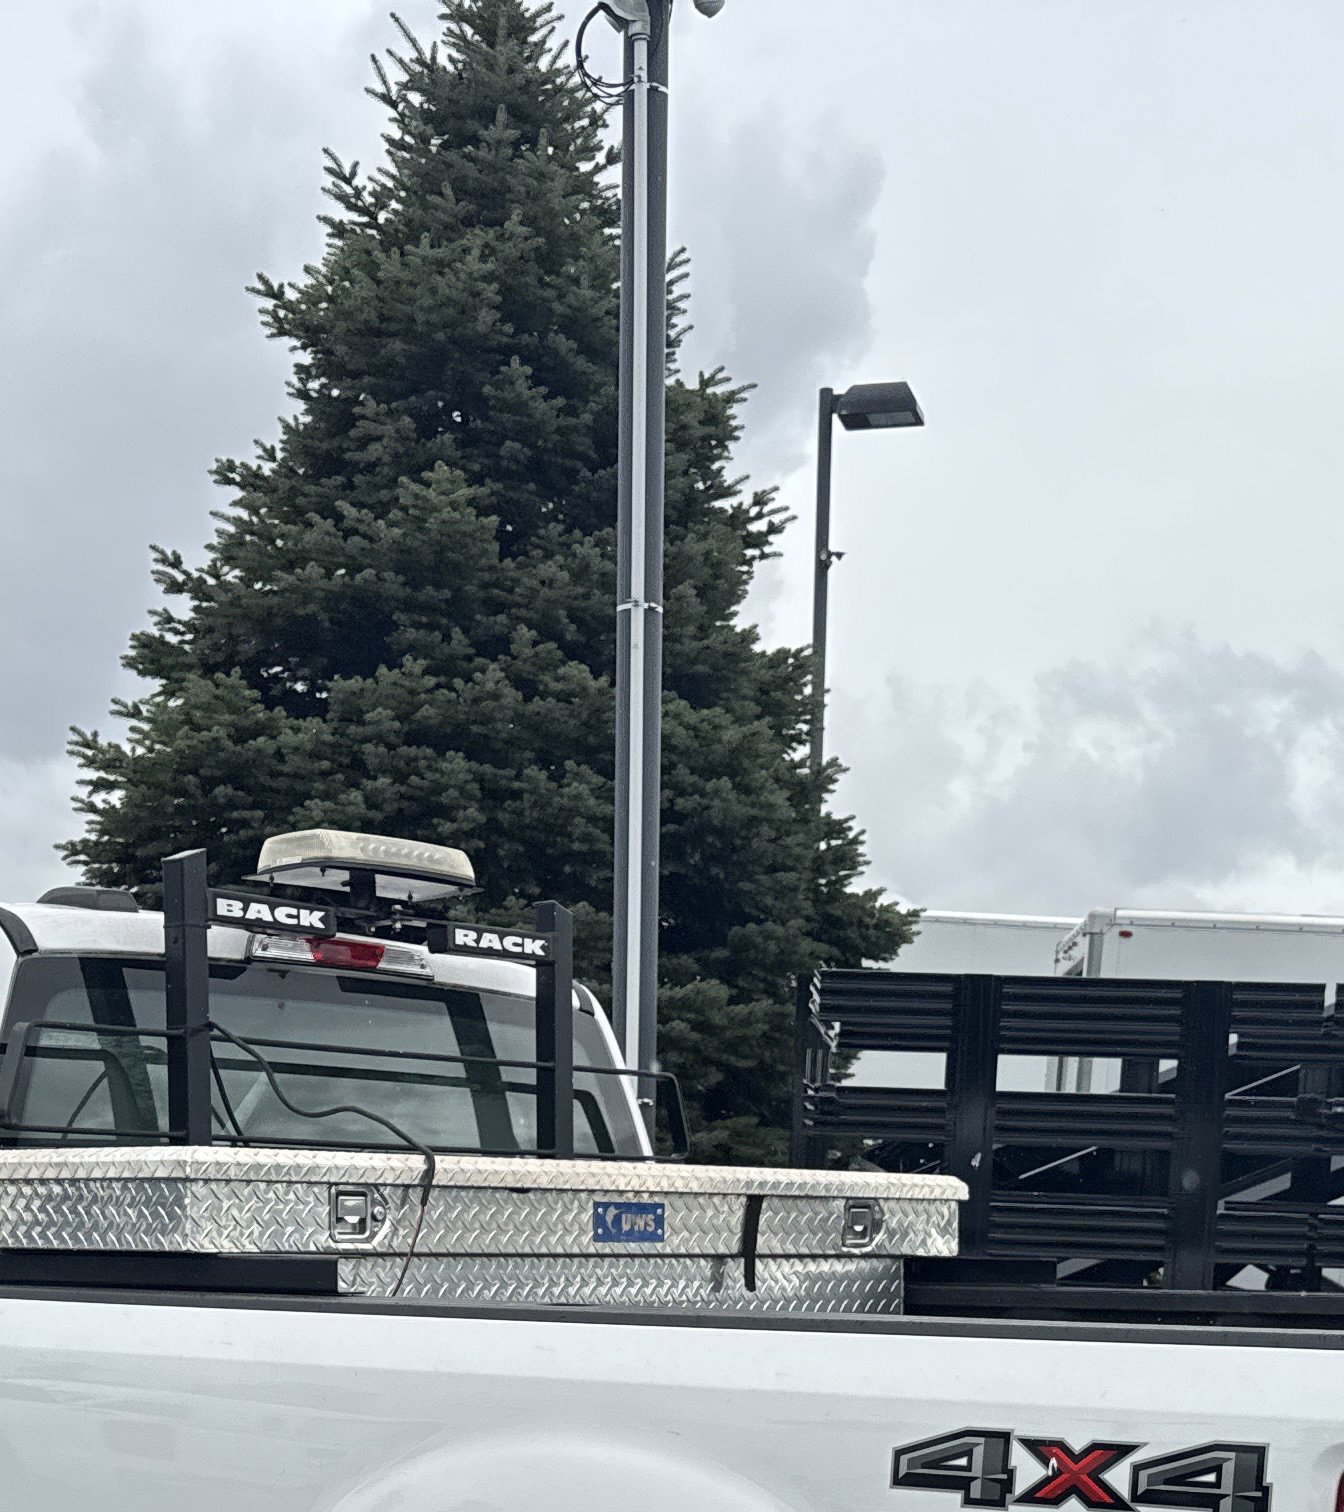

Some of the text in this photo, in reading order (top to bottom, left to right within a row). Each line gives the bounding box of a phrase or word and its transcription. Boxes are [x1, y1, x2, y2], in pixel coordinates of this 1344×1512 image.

[216, 897, 546, 956] BACK RACK
[621, 1213, 656, 1233] UWS
